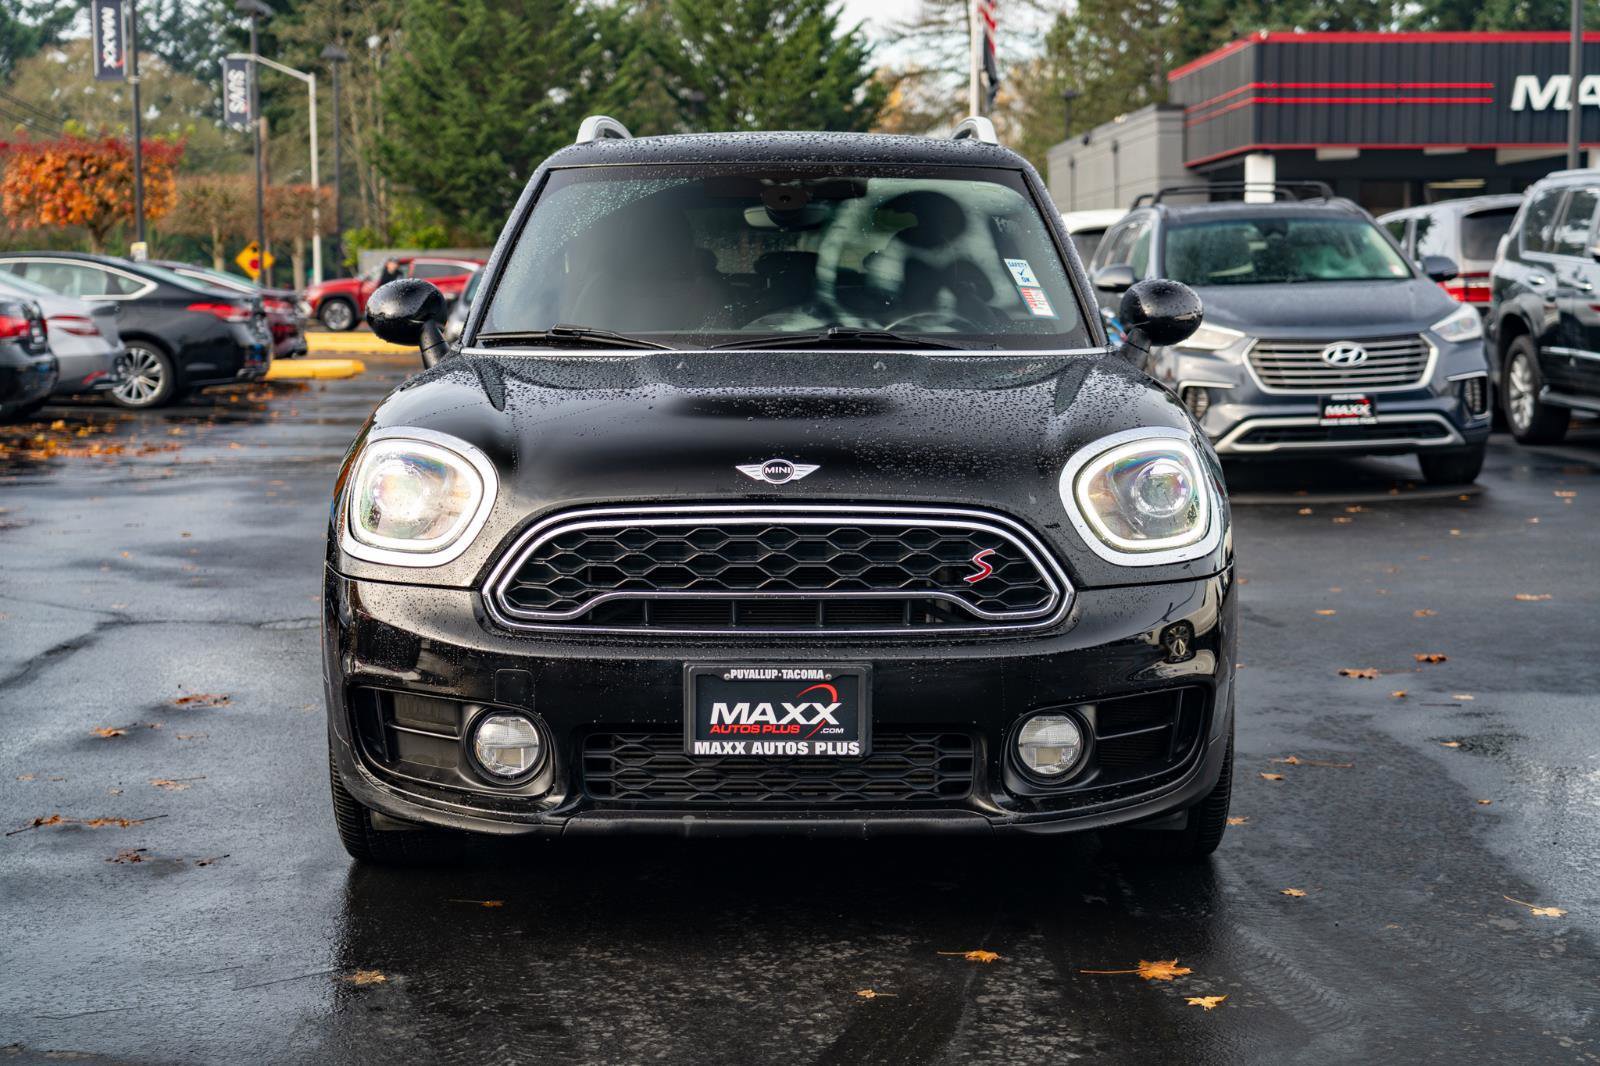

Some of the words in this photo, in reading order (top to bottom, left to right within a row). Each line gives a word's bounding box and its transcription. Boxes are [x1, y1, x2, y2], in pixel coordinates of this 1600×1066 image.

[101, 6, 117, 68] MAXX
[765, 466, 791, 474] MINI
[963, 548, 996, 583] S
[710, 702, 843, 725] MAXX
[709, 724, 760, 735] AUTOS
[762, 724, 800, 735] PLUS
[694, 741, 746, 755] MAXX
[751, 741, 809, 755] AUTOS
[815, 741, 860, 755] PLUS
